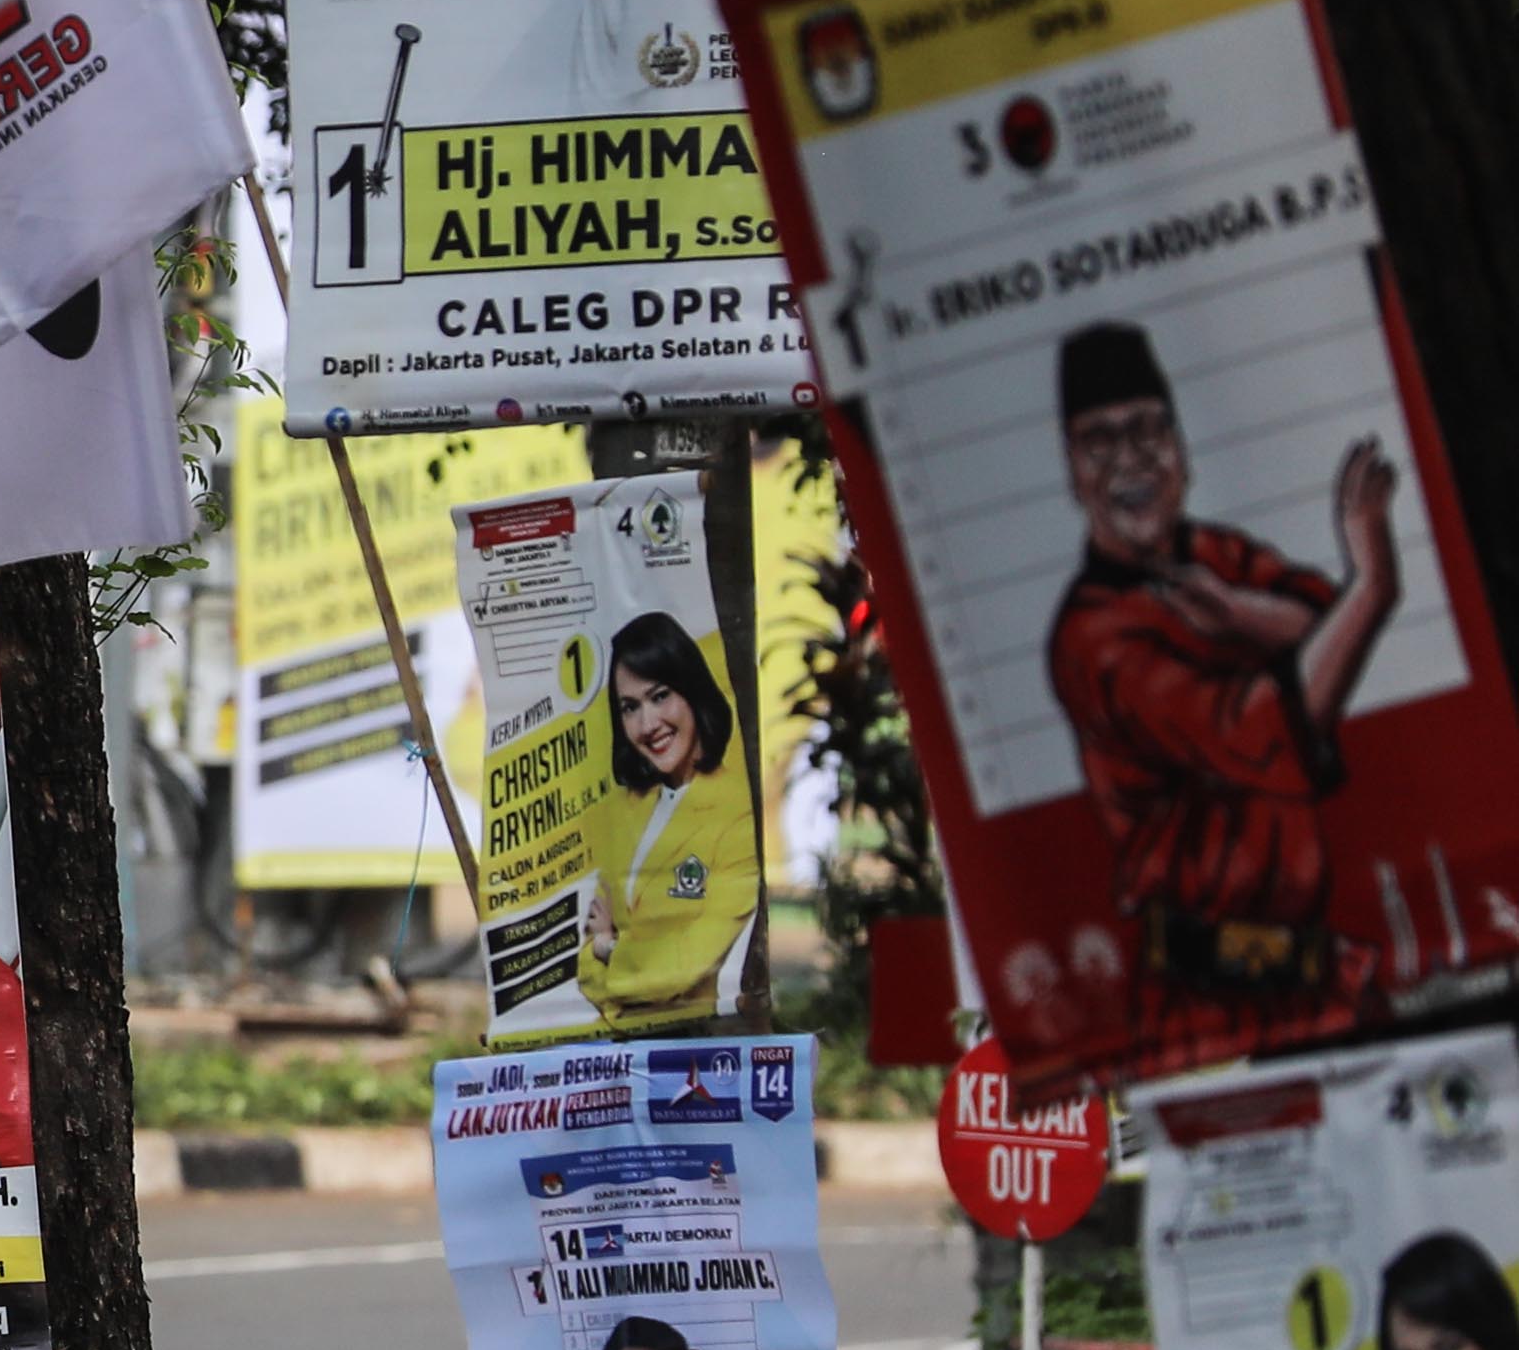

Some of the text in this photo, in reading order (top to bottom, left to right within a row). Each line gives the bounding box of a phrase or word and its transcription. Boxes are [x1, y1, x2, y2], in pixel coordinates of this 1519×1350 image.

[436, 138, 511, 199] Hj.
[328, 143, 368, 270] 1
[431, 199, 680, 260] ALIYAH,
[438, 288, 741, 337] CALEG DPR
[322, 335, 750, 378] Dapil Jakarta Pusat, Jakarta Selatan
[617, 507, 634, 537] 4
[566, 640, 583, 694] 1
[490, 720, 588, 809] CHRISTINA
[490, 788, 563, 857] ARYANI
[753, 1048, 791, 1061] INGAT
[756, 1065, 788, 1099] 14
[447, 1097, 561, 1139] LANJUTKAN
[988, 1146, 1057, 1206] OUT
[551, 1230, 583, 1261] 14
[695, 1258, 755, 1291] JOHAN
[1307, 1277, 1328, 1349] 1
